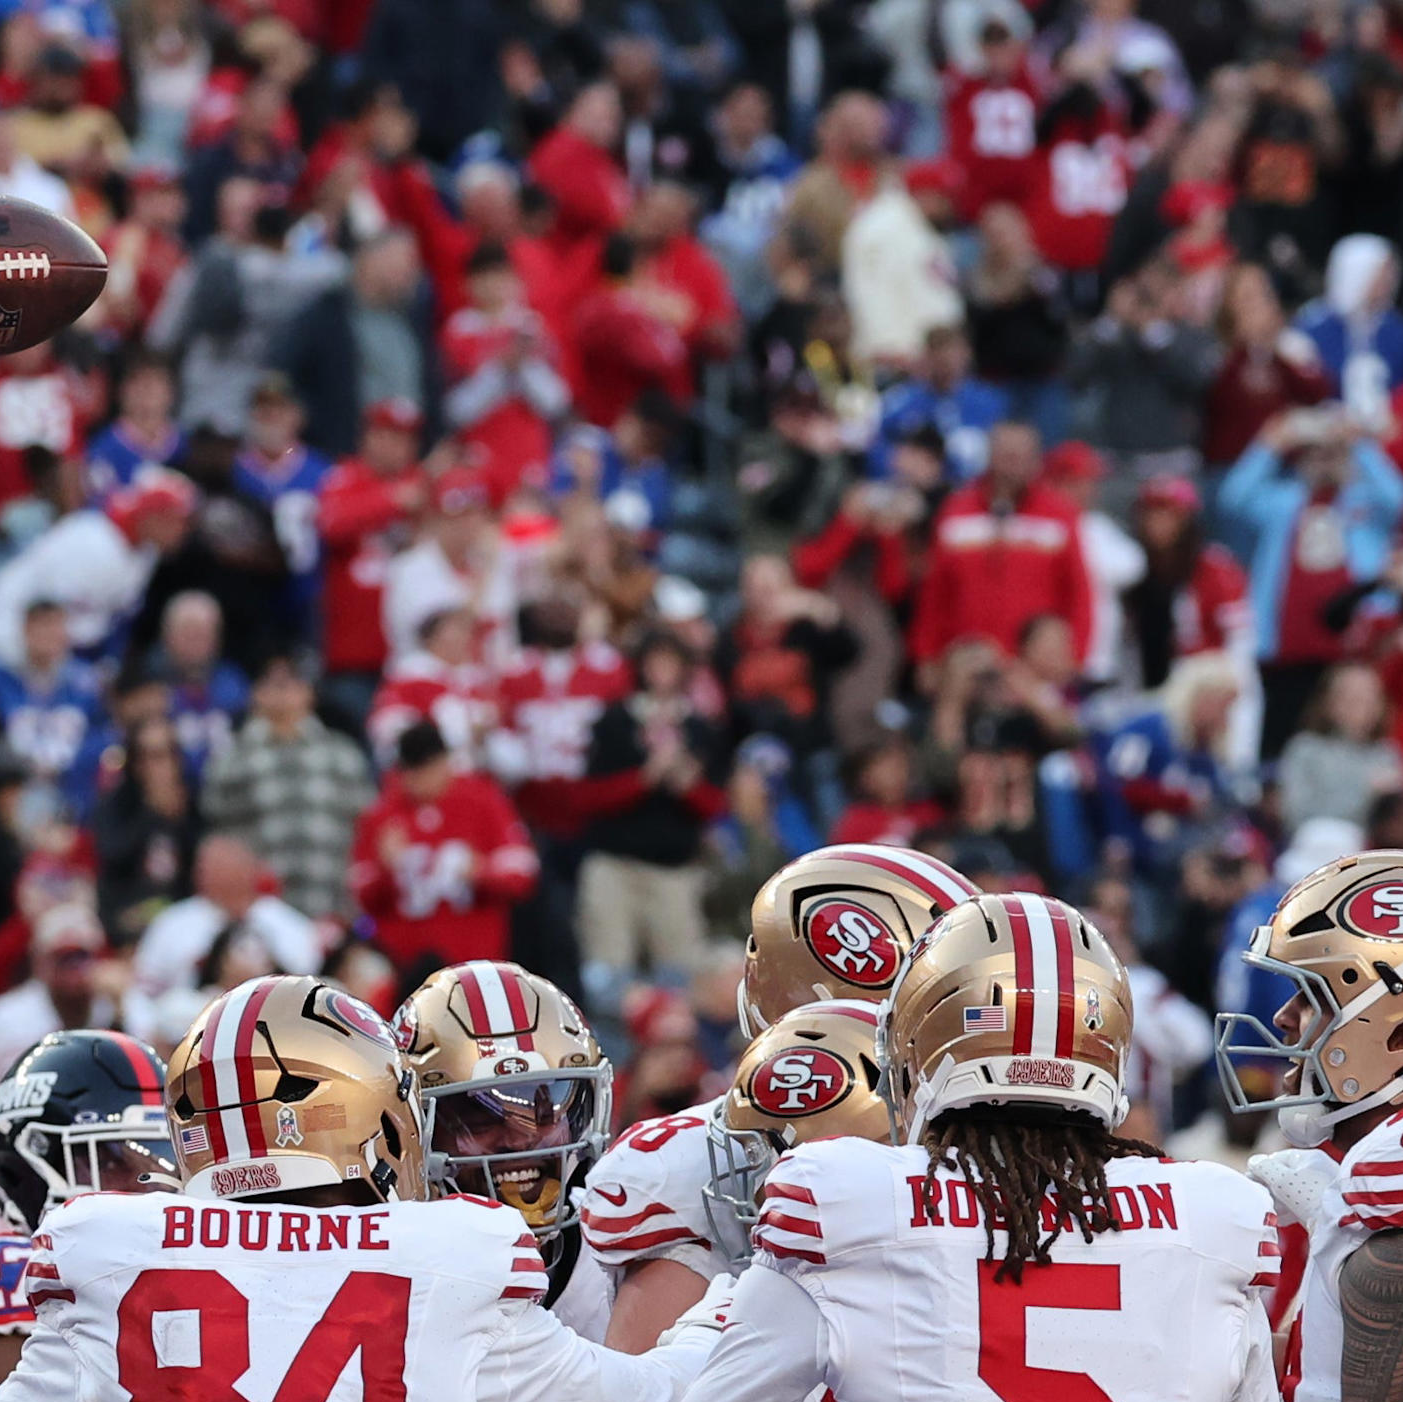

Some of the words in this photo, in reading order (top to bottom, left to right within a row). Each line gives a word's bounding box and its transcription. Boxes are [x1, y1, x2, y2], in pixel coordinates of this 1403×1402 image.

[769, 1055, 833, 1109] SF
[1005, 1060, 1076, 1090] 49ERS
[211, 1163, 281, 1196] 49ERS
[162, 1206, 390, 1252] BOURNE
